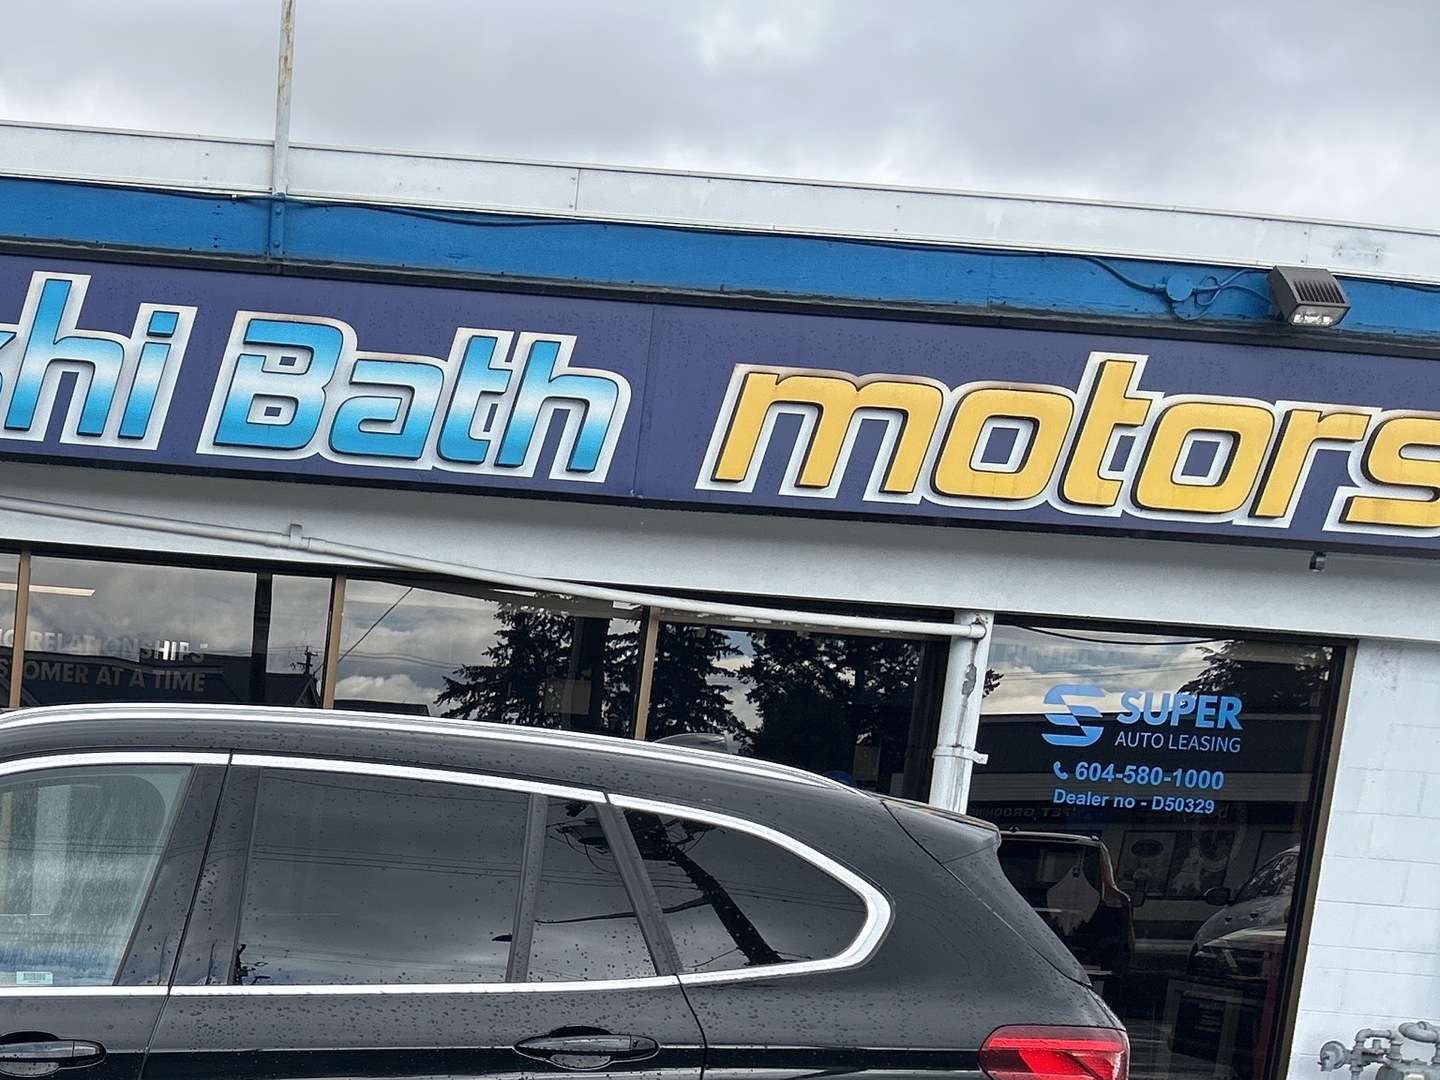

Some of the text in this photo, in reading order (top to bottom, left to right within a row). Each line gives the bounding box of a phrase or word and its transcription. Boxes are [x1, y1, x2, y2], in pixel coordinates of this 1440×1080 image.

[196, 310, 631, 482] Bath
[695, 351, 1440, 539] motors
[96, 665, 124, 686] AT
[129, 669, 146, 687] A
[152, 670, 206, 692] TIME
[1116, 689, 1244, 730] SUPER
[1115, 731, 1241, 753] AUTO LEASING
[1075, 762, 1225, 790] 604-580-1000
[1053, 789, 1109, 807] Dealer
[1113, 795, 1135, 808] no
[1152, 796, 1215, 814] D50329
